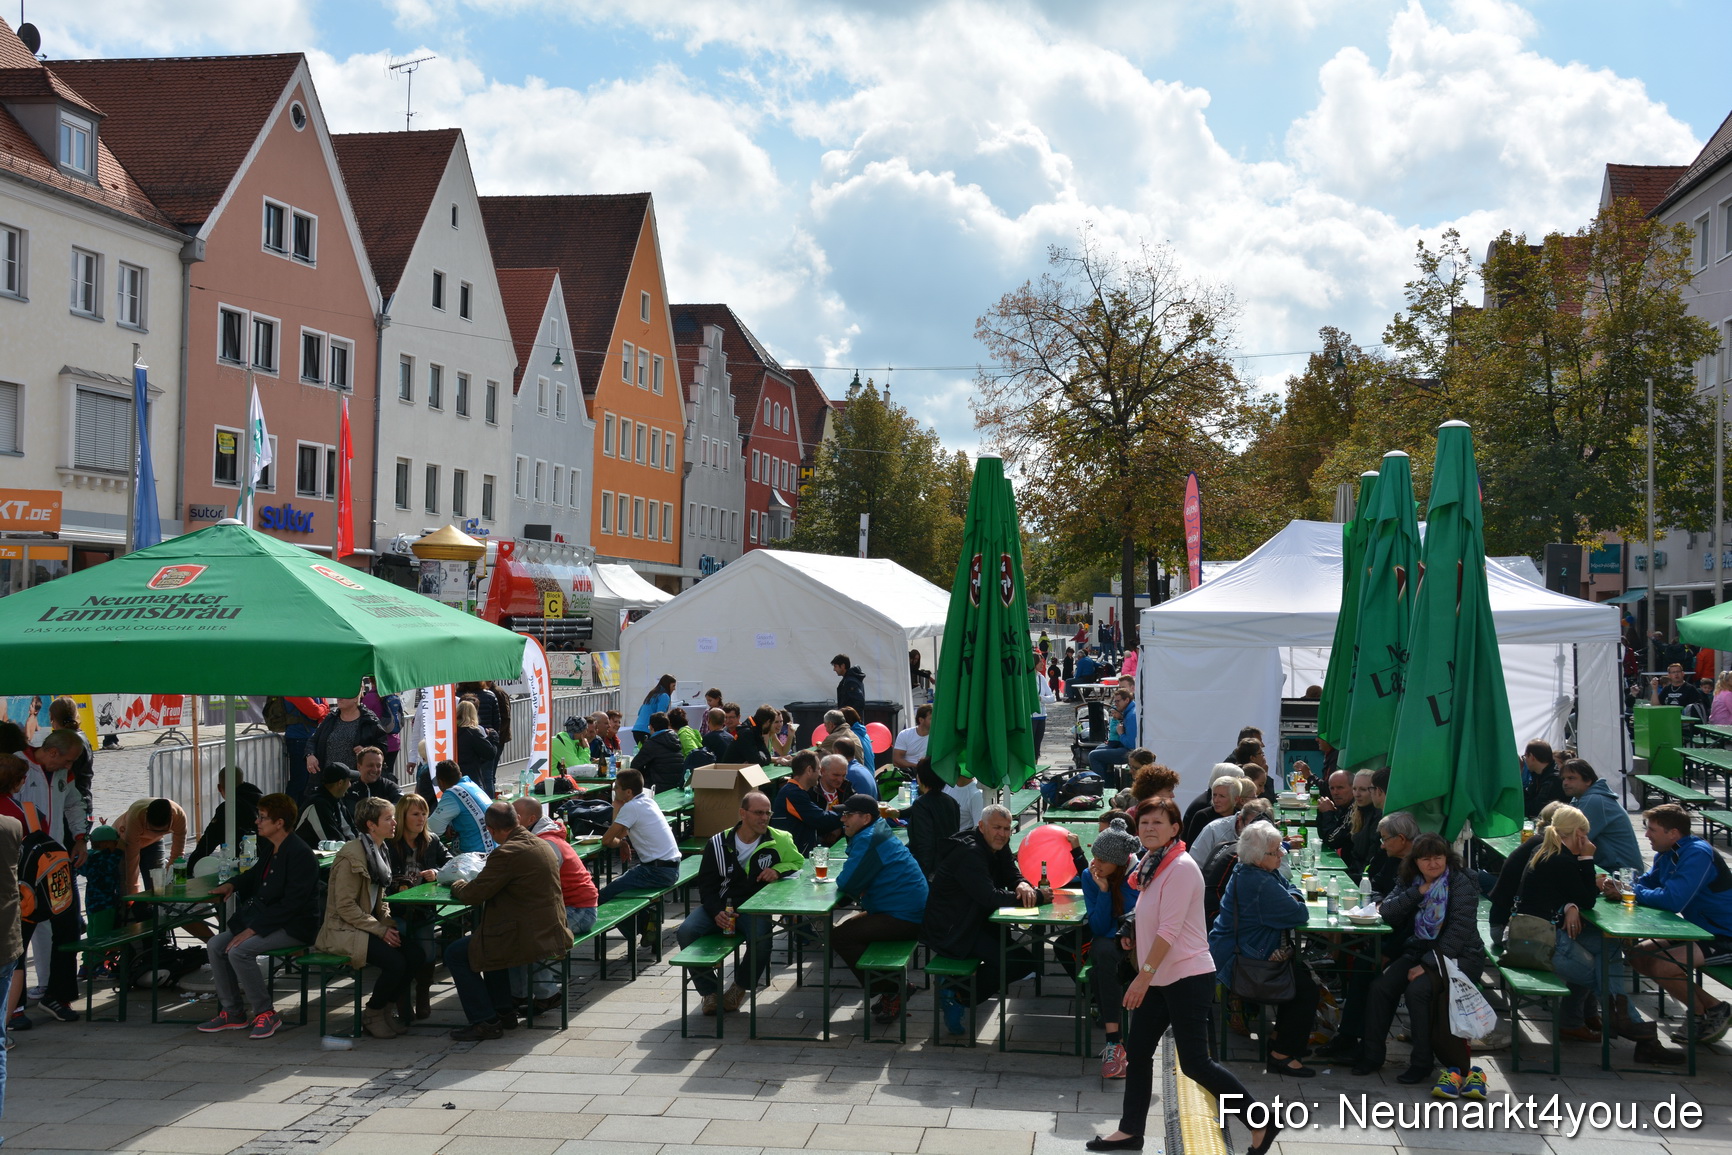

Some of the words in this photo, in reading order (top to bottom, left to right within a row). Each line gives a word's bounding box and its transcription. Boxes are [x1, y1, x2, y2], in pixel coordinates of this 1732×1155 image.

[572, 575, 593, 593] AVIA
[81, 593, 229, 607] Neumarkter
[548, 600, 558, 613] C
[570, 593, 592, 611] Pellets
[37, 604, 244, 622] Lammsbräu
[95, 624, 194, 632] ÖKOLOGISCHE
[163, 705, 181, 717] Braun
